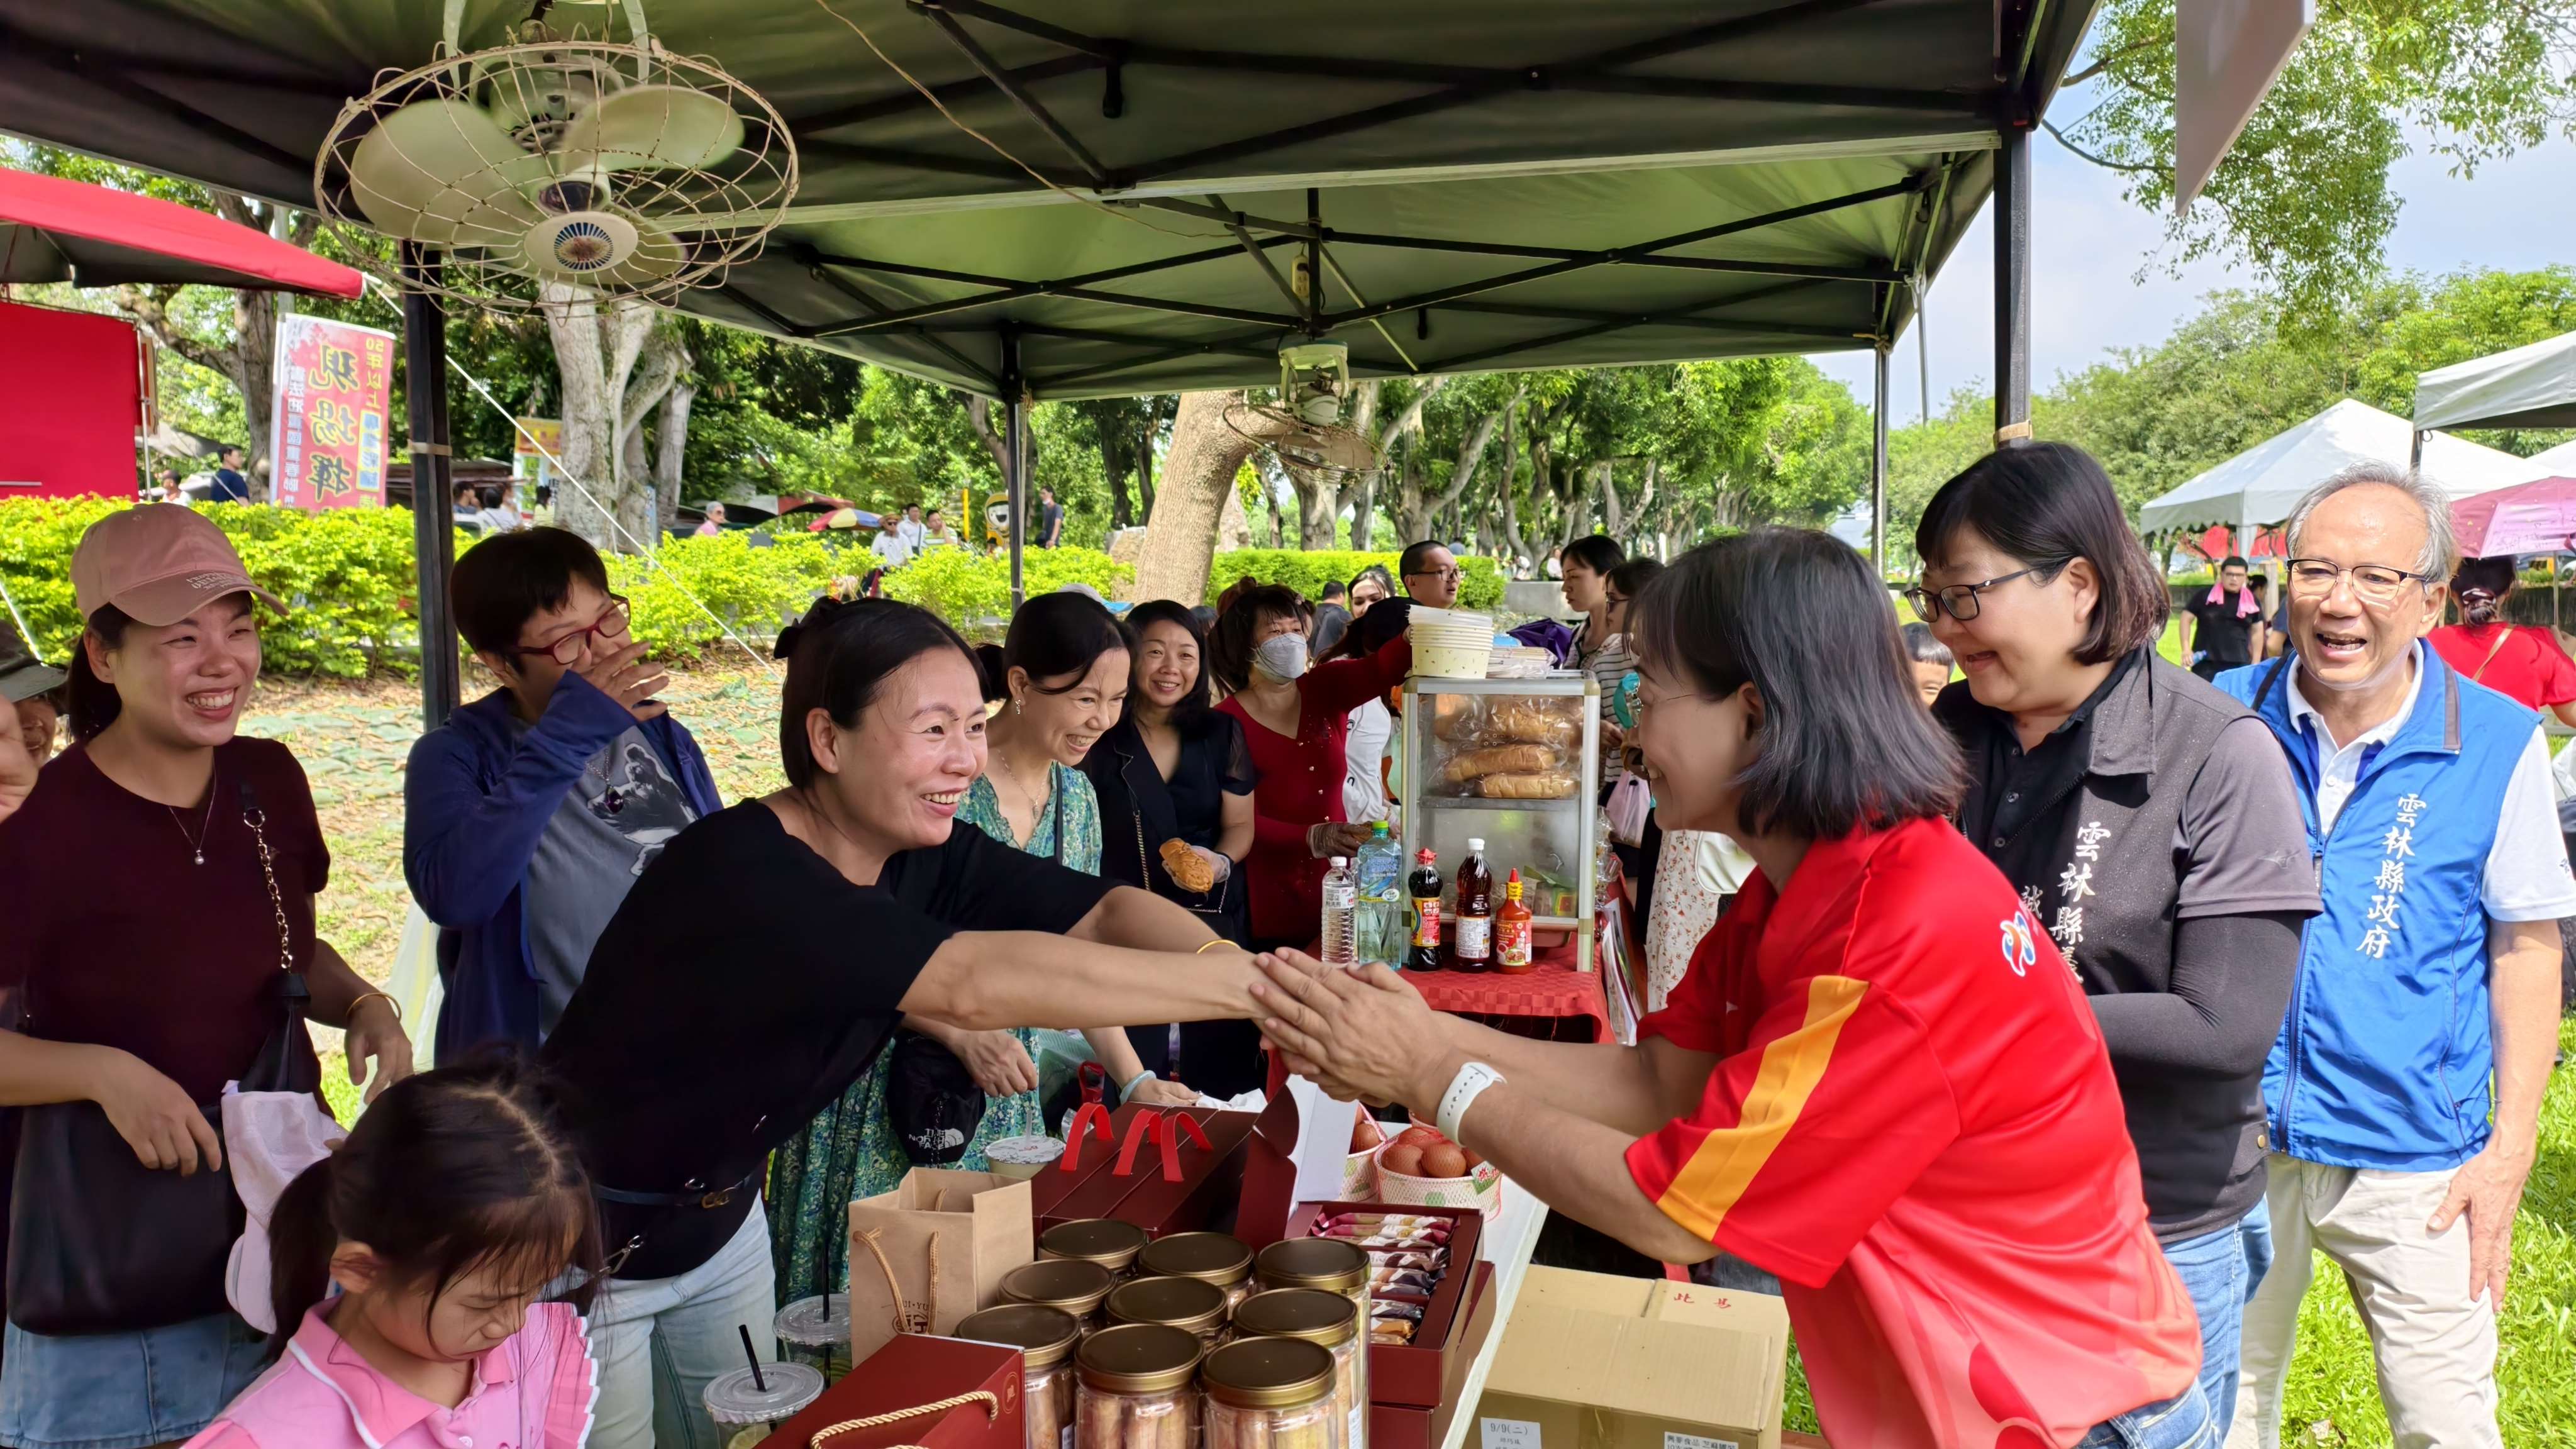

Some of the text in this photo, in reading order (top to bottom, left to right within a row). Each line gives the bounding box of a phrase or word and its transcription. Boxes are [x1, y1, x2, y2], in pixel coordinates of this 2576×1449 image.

[2355, 793, 2427, 959] 雲林縣政府
[1490, 1422, 1528, 1435] 9/9(二)
